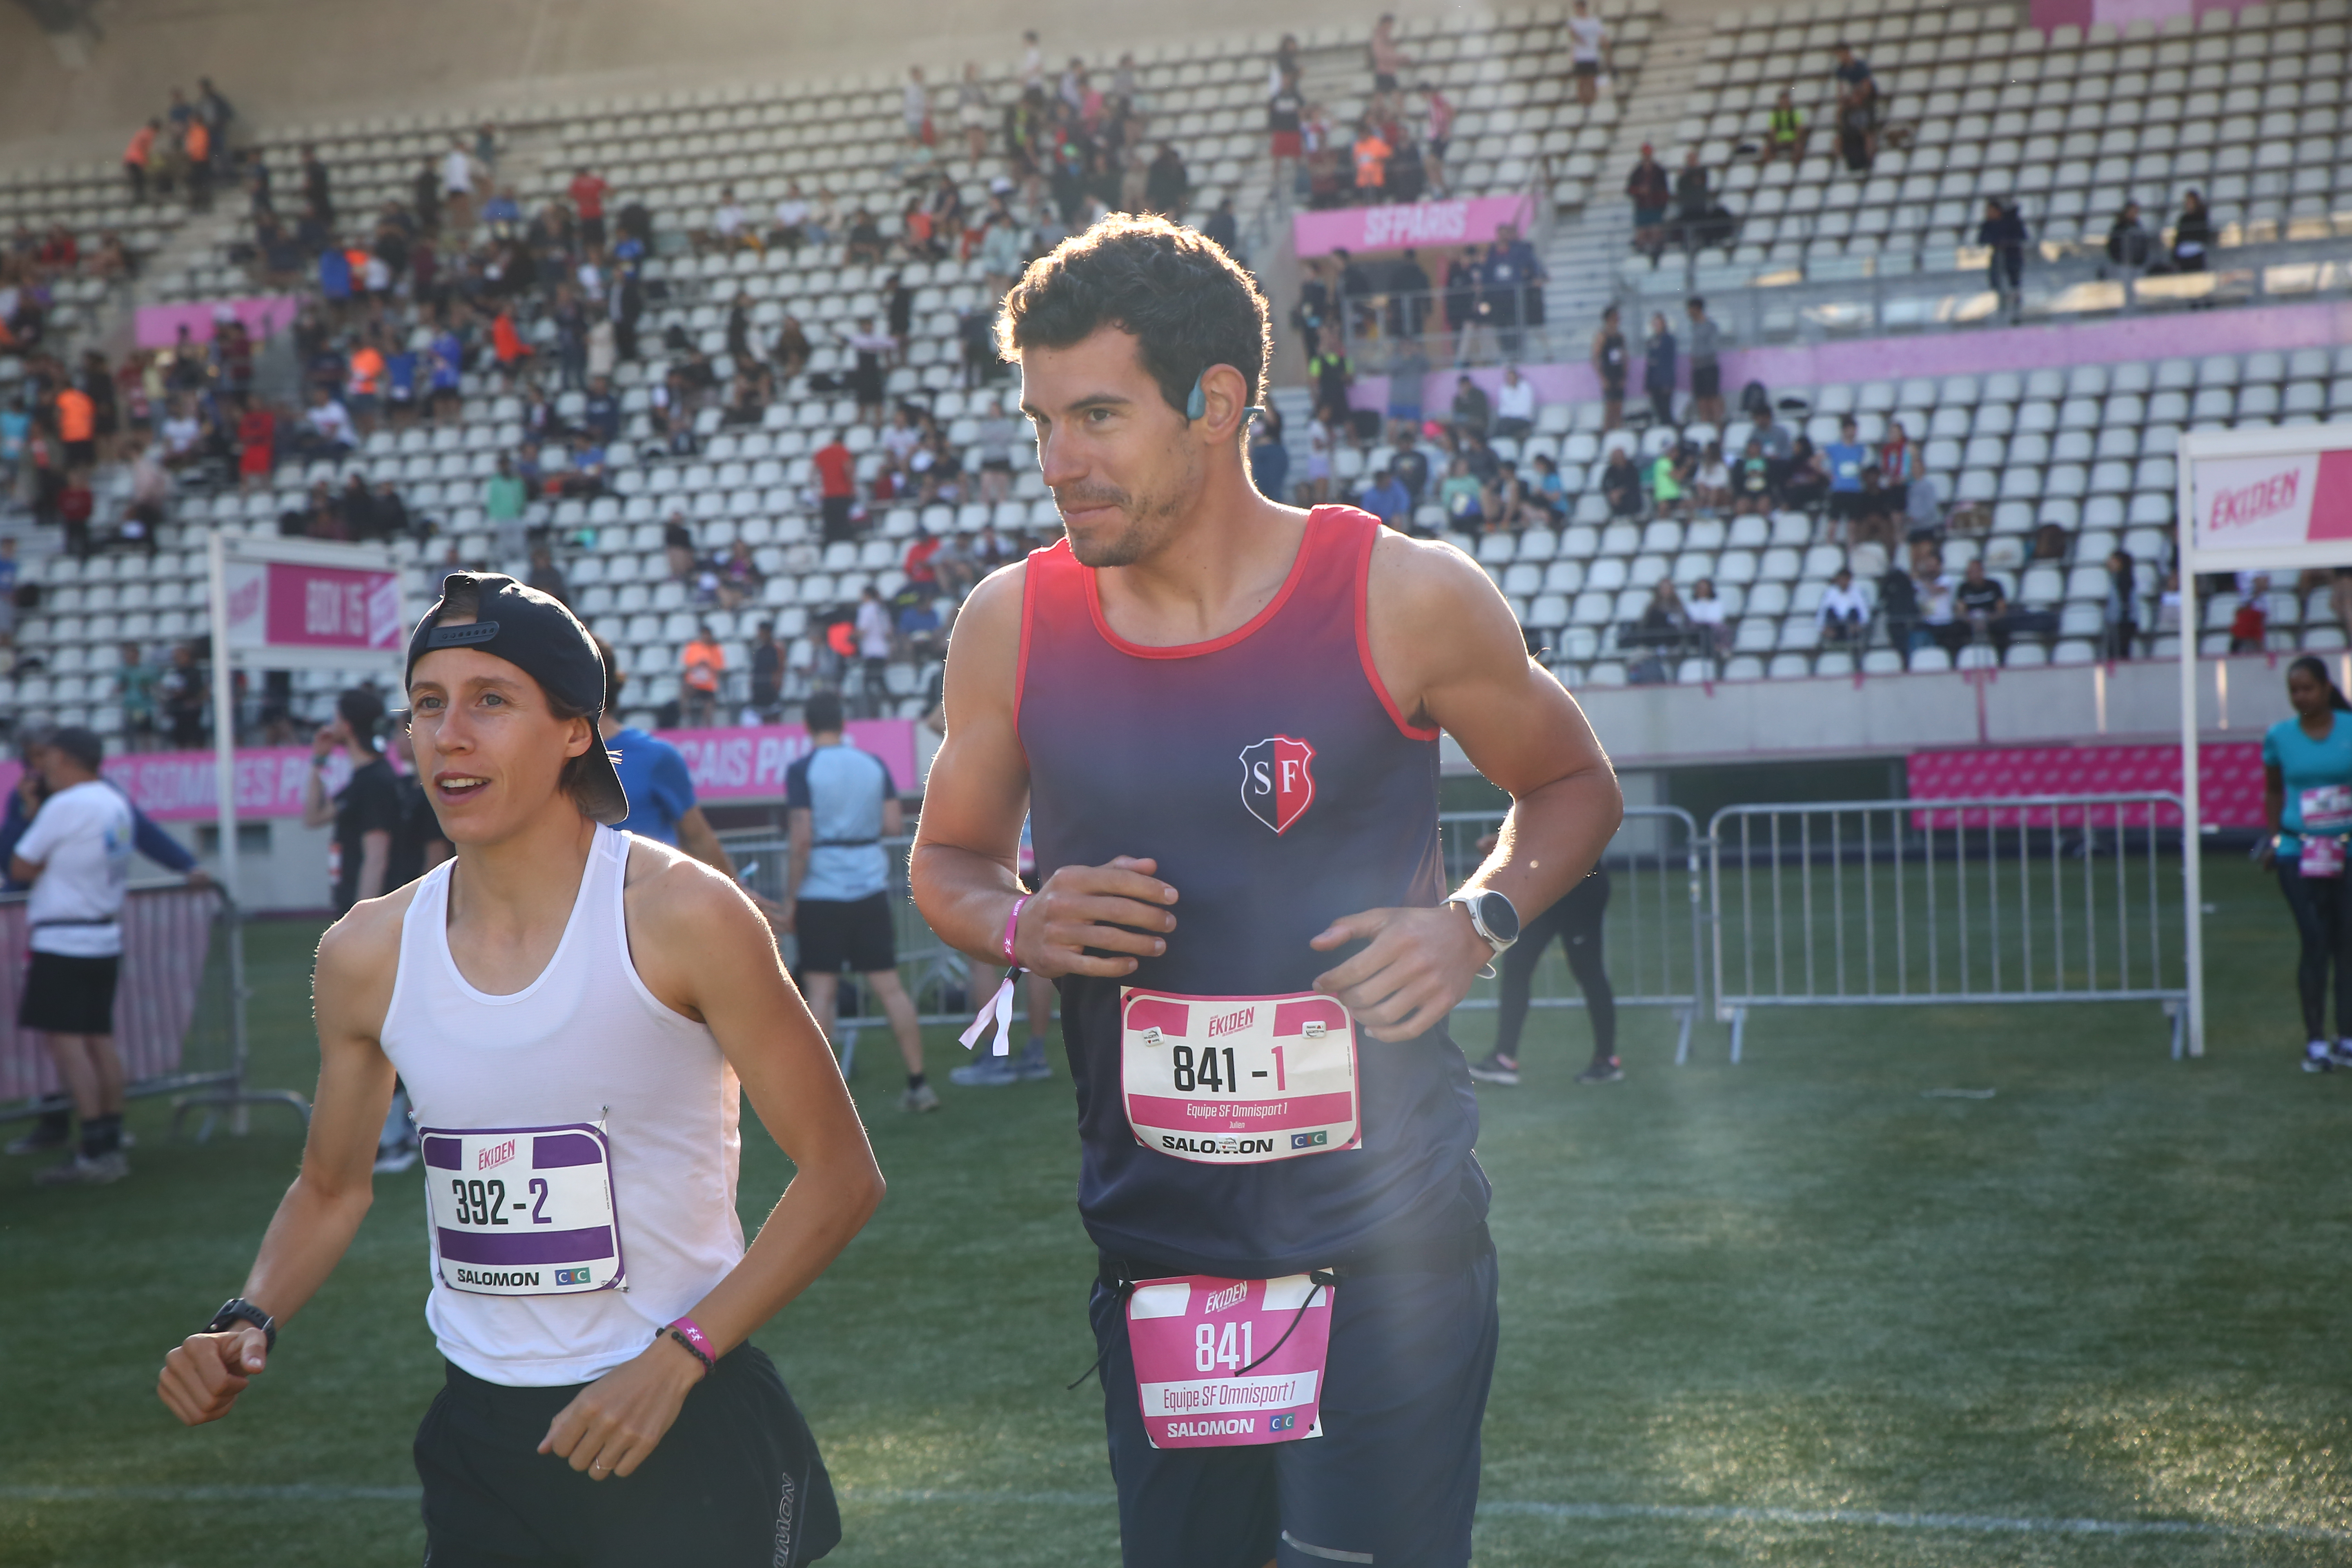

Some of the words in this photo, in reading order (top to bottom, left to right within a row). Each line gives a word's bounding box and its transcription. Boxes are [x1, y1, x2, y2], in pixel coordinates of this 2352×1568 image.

[1209, 1006, 1255, 1038] EKIDEN
[1187, 1104, 1217, 1119] Equipe
[1219, 1105, 1230, 1117] SF
[1232, 1102, 1283, 1118] Omnisport
[1283, 1102, 1287, 1114] 1
[479, 1138, 515, 1171] EKIDEN
[457, 1269, 539, 1286] SALOMON
[1205, 1281, 1247, 1314] EKIDEN
[1195, 1321, 1252, 1372] 841
[1164, 1387, 1199, 1412] Equipe
[1202, 1385, 1217, 1406] SF
[1219, 1382, 1288, 1407] Omnisport
[1289, 1380, 1296, 1401] 1
[1167, 1418, 1255, 1438] SALOMON
